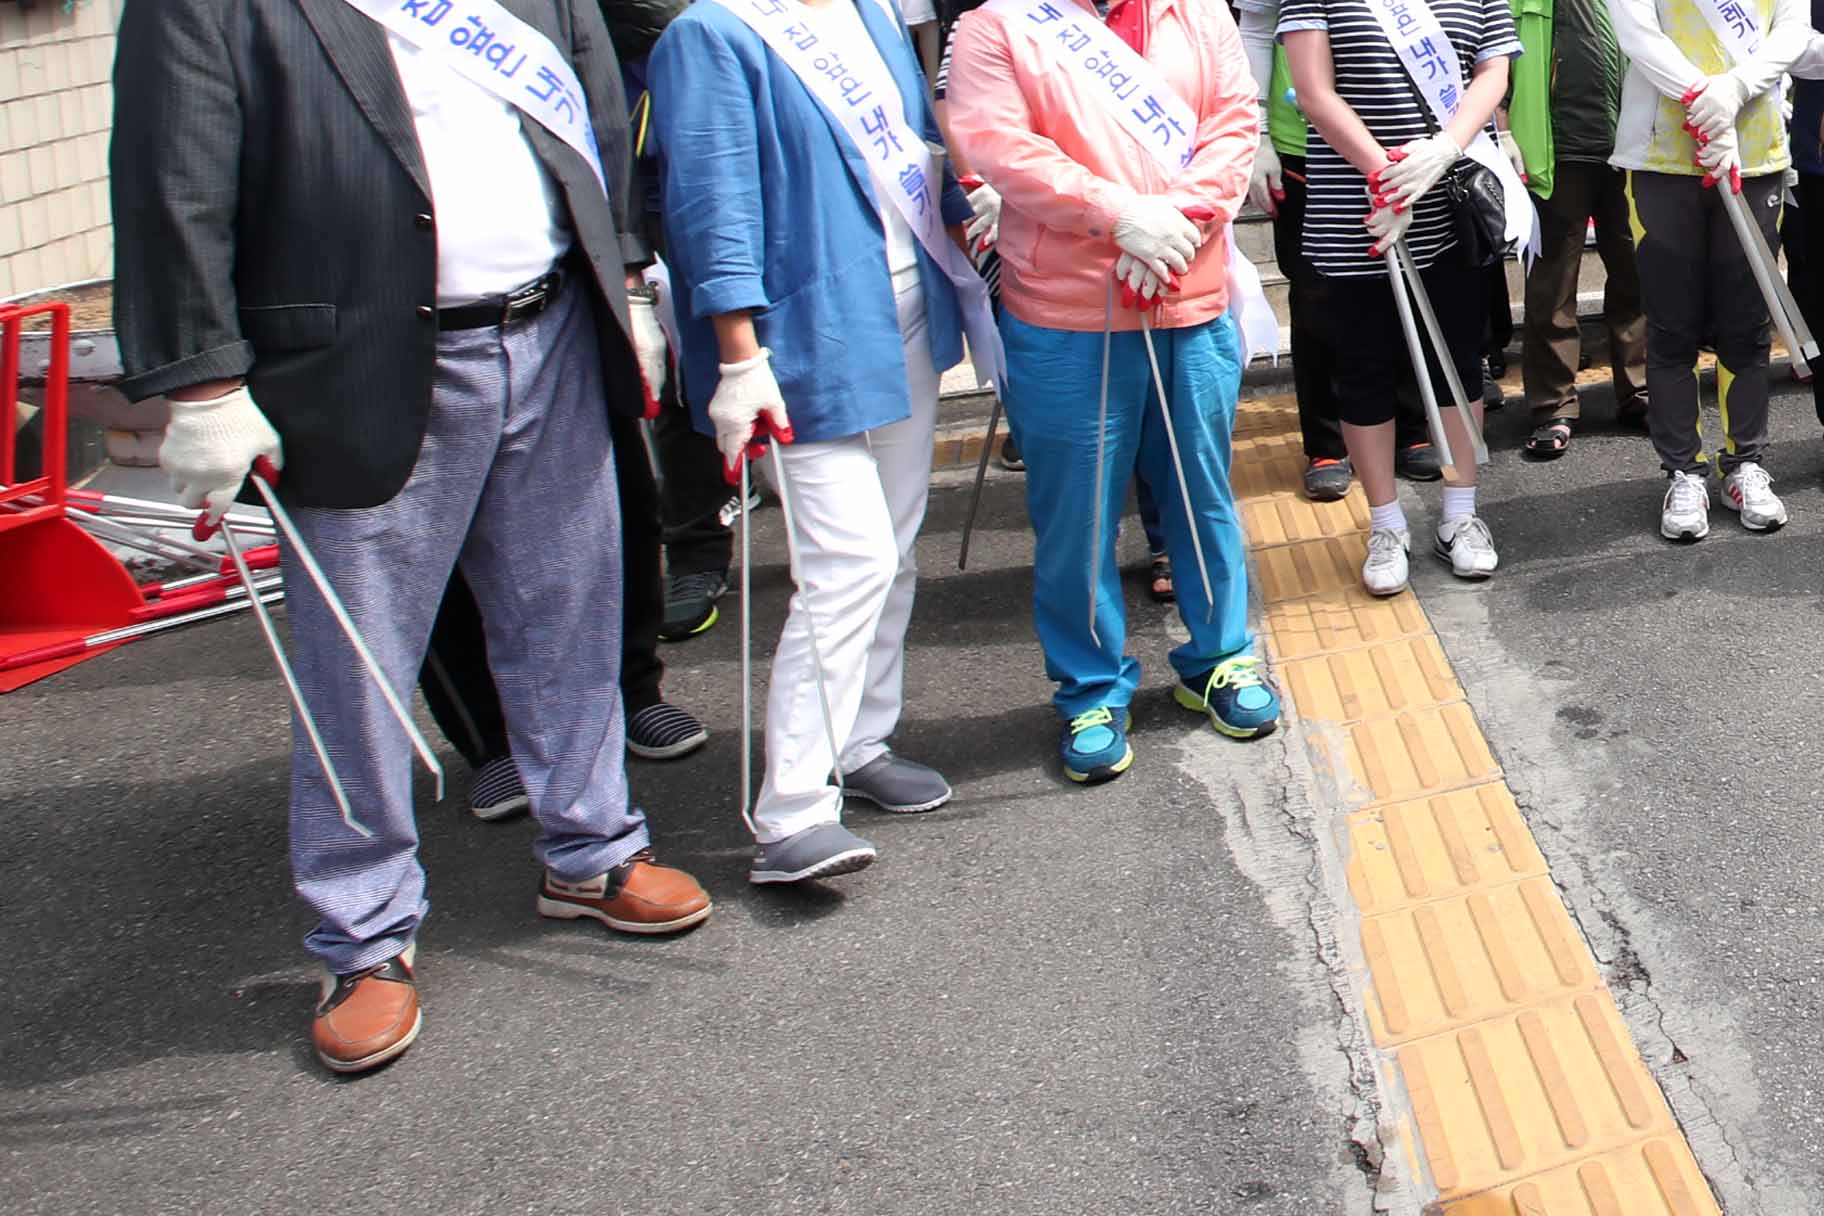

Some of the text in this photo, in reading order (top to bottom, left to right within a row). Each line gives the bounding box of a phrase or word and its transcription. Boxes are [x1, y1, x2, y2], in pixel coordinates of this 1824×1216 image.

[448, 14, 529, 79] 앞은
[524, 64, 583, 125] 내가
[782, 21, 819, 53] 집
[812, 50, 873, 107] 앞은
[860, 103, 905, 162] 내가
[1026, 1, 1188, 146] 내 집 앞은 내가
[1409, 36, 1450, 81] 내가
